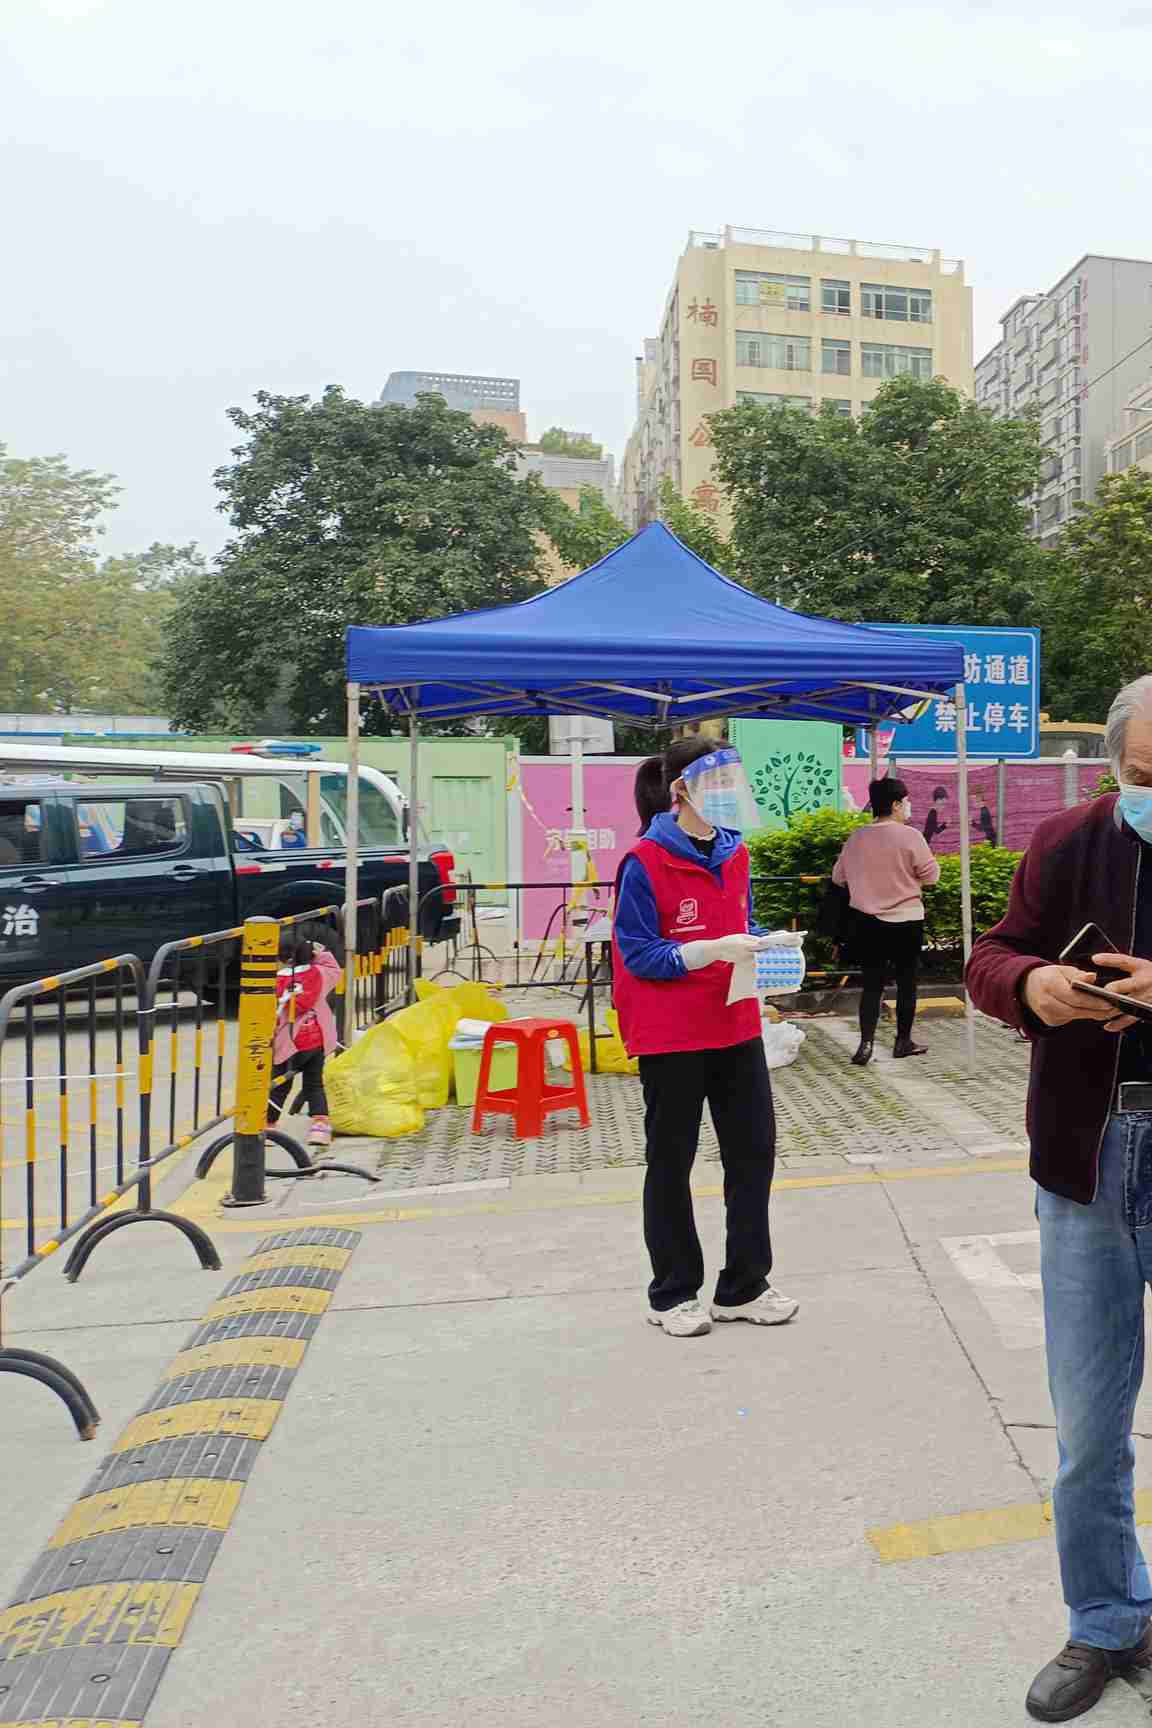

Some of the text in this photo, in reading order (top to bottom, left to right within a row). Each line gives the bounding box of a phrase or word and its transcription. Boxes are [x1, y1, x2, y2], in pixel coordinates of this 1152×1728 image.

[935, 702, 1029, 734] 禁止停车
[2, 903, 41, 936] 治
